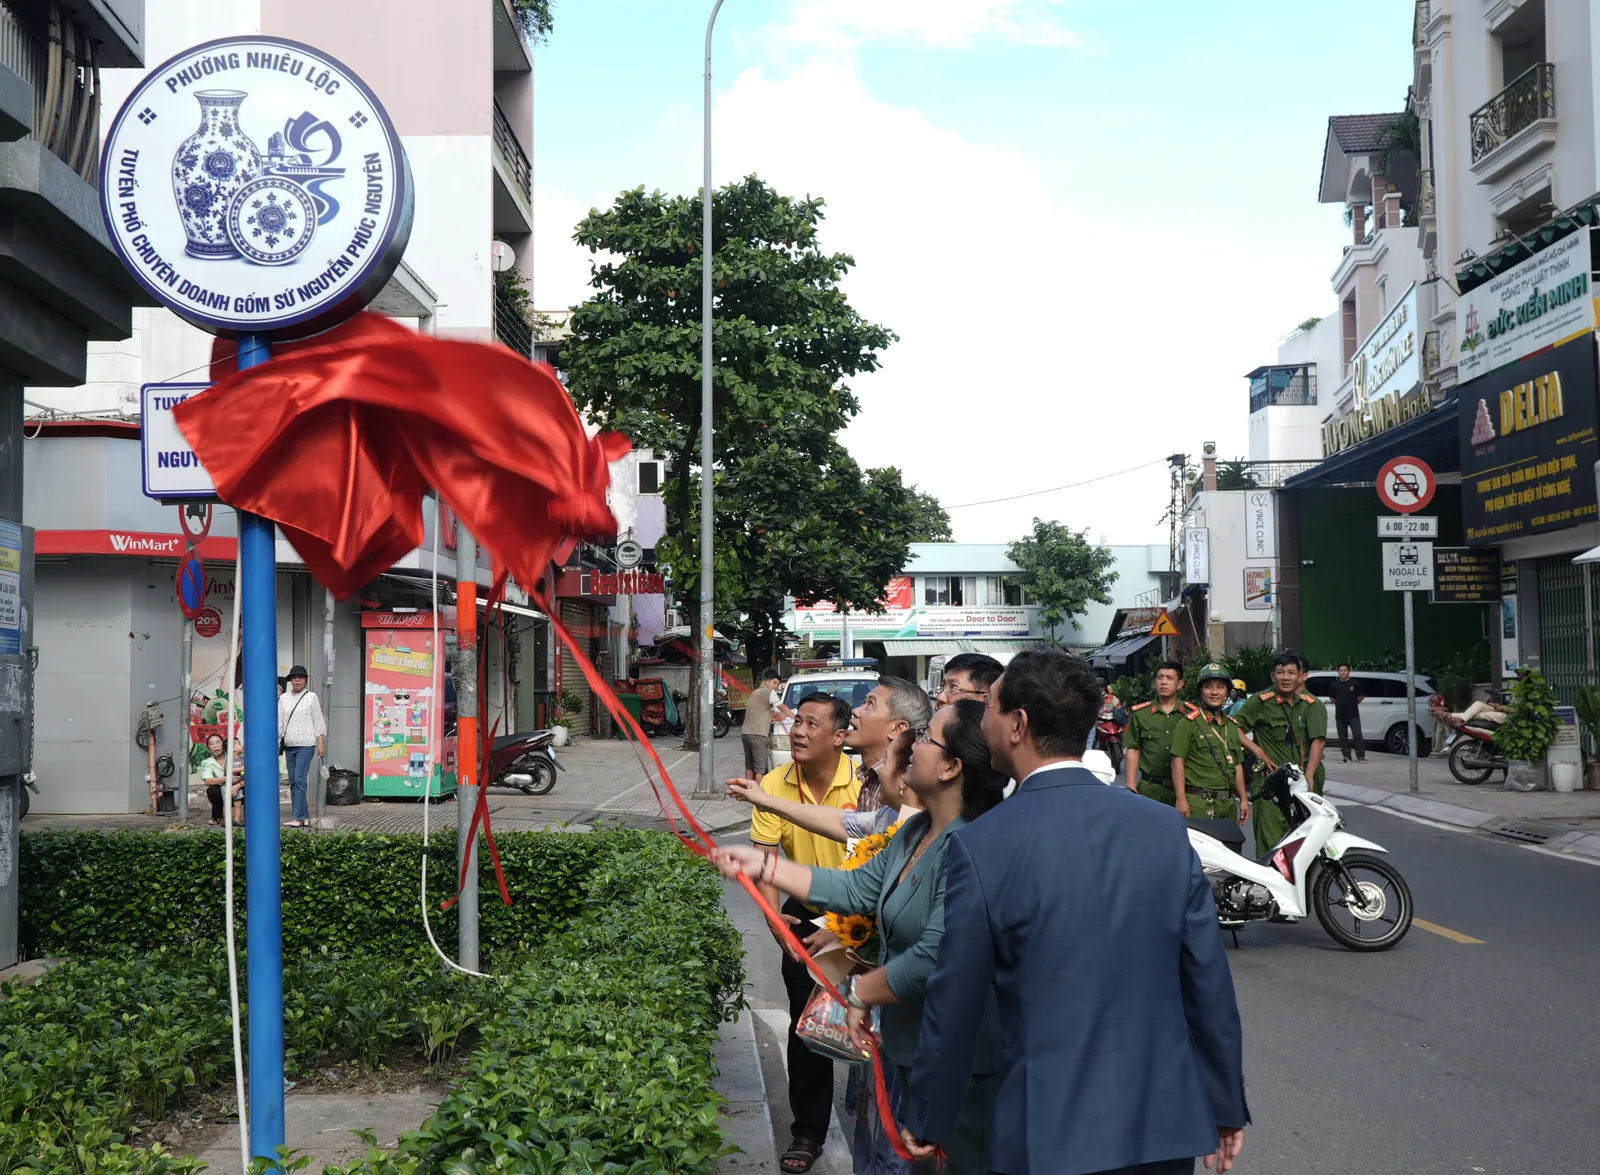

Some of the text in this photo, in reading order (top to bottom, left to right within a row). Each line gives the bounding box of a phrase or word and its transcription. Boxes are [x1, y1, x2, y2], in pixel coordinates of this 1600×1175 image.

[165, 52, 340, 96] PHƯỜNG NHIÊU LỘC
[118, 149, 384, 314] TUYẾN PHỐ CHUYÊN DOANH GỐM SỨ NGUYỄN PHÚC NGUYÊN
[1501, 257, 1570, 302] CÔNG TY LUẬT TNHH
[1487, 308, 1515, 339] ĐỨC
[1550, 273, 1587, 309] MINH
[1371, 390, 1401, 434] MAI
[1402, 387, 1435, 421] Hotel
[1500, 370, 1563, 436] DELTA
[158, 451, 204, 468] NGUY
[1256, 509, 1264, 552] VINCE CLINIC
[1386, 522, 1402, 531] 6:00
[1389, 566, 1428, 578] NGOẠI LỆ
[1438, 554, 1459, 563] DELTA
[1395, 580, 1420, 588] Except
[197, 616, 218, 625] 20%
[414, 660, 428, 670] 10K
